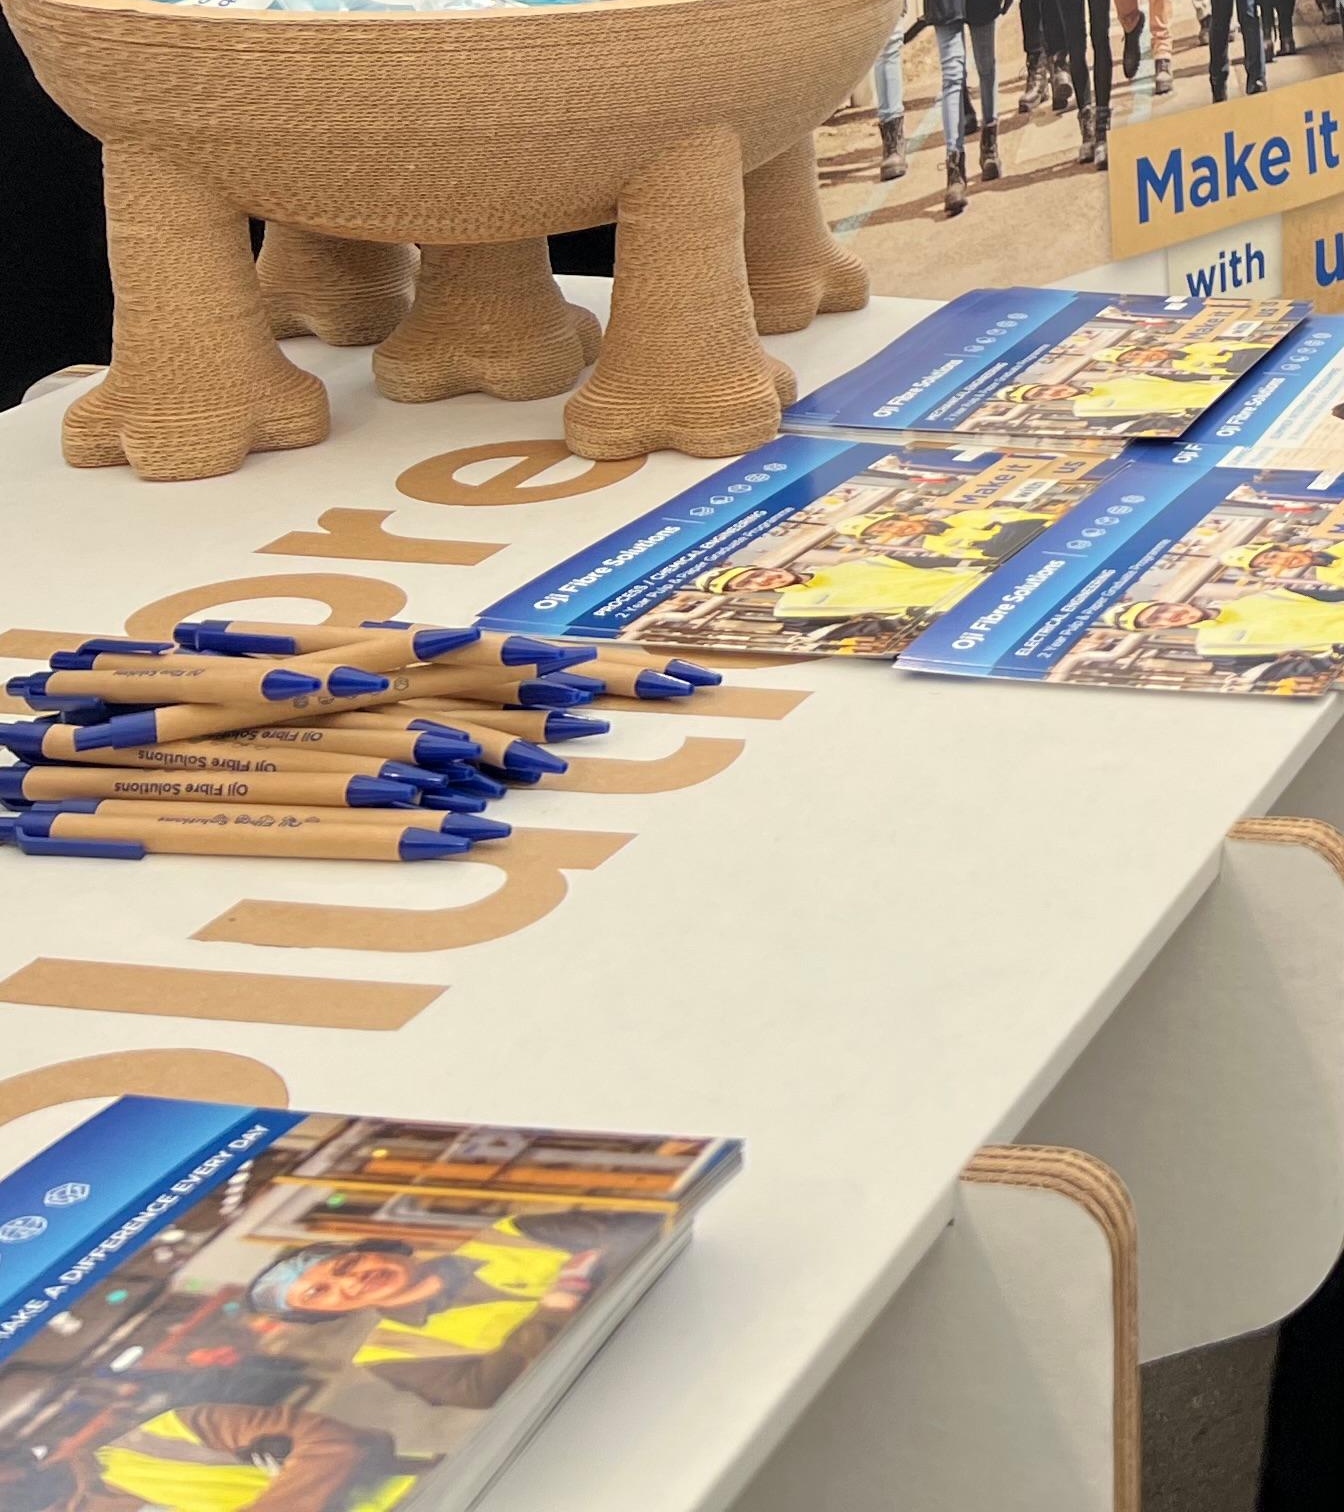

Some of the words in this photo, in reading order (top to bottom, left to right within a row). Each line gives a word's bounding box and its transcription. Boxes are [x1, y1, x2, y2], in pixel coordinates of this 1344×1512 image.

[1136, 131, 1291, 224] Make
[1304, 110, 1340, 175] it
[1186, 243, 1265, 297] with
[954, 474, 1017, 504] Make
[533, 594, 569, 610] Oji
[560, 566, 613, 594] Fibre
[608, 525, 681, 567] Solutions
[593, 584, 649, 618] PROCESS
[652, 550, 700, 581] CHEMICAL
[699, 510, 768, 551] ENGINEERING
[952, 631, 985, 650] Oji
[975, 600, 1016, 631] Fibre
[1008, 559, 1066, 603] Solutions
[1015, 609, 1069, 657] ELECTRICAL
[1062, 569, 1116, 614] ENGINEERING
[262, 729, 299, 741] Fibre
[301, 730, 323, 742] Oji
[138, 749, 206, 768] Solutions
[211, 757, 250, 772] Fibre
[114, 781, 181, 796] Solutions
[185, 783, 224, 796] Fibre
[228, 783, 248, 796] Oji
[43, 1284, 69, 1300] A
[59, 1193, 180, 1284] DIFFERENCE
[170, 1150, 234, 1194] EVERY
[228, 1124, 270, 1152] DAY
